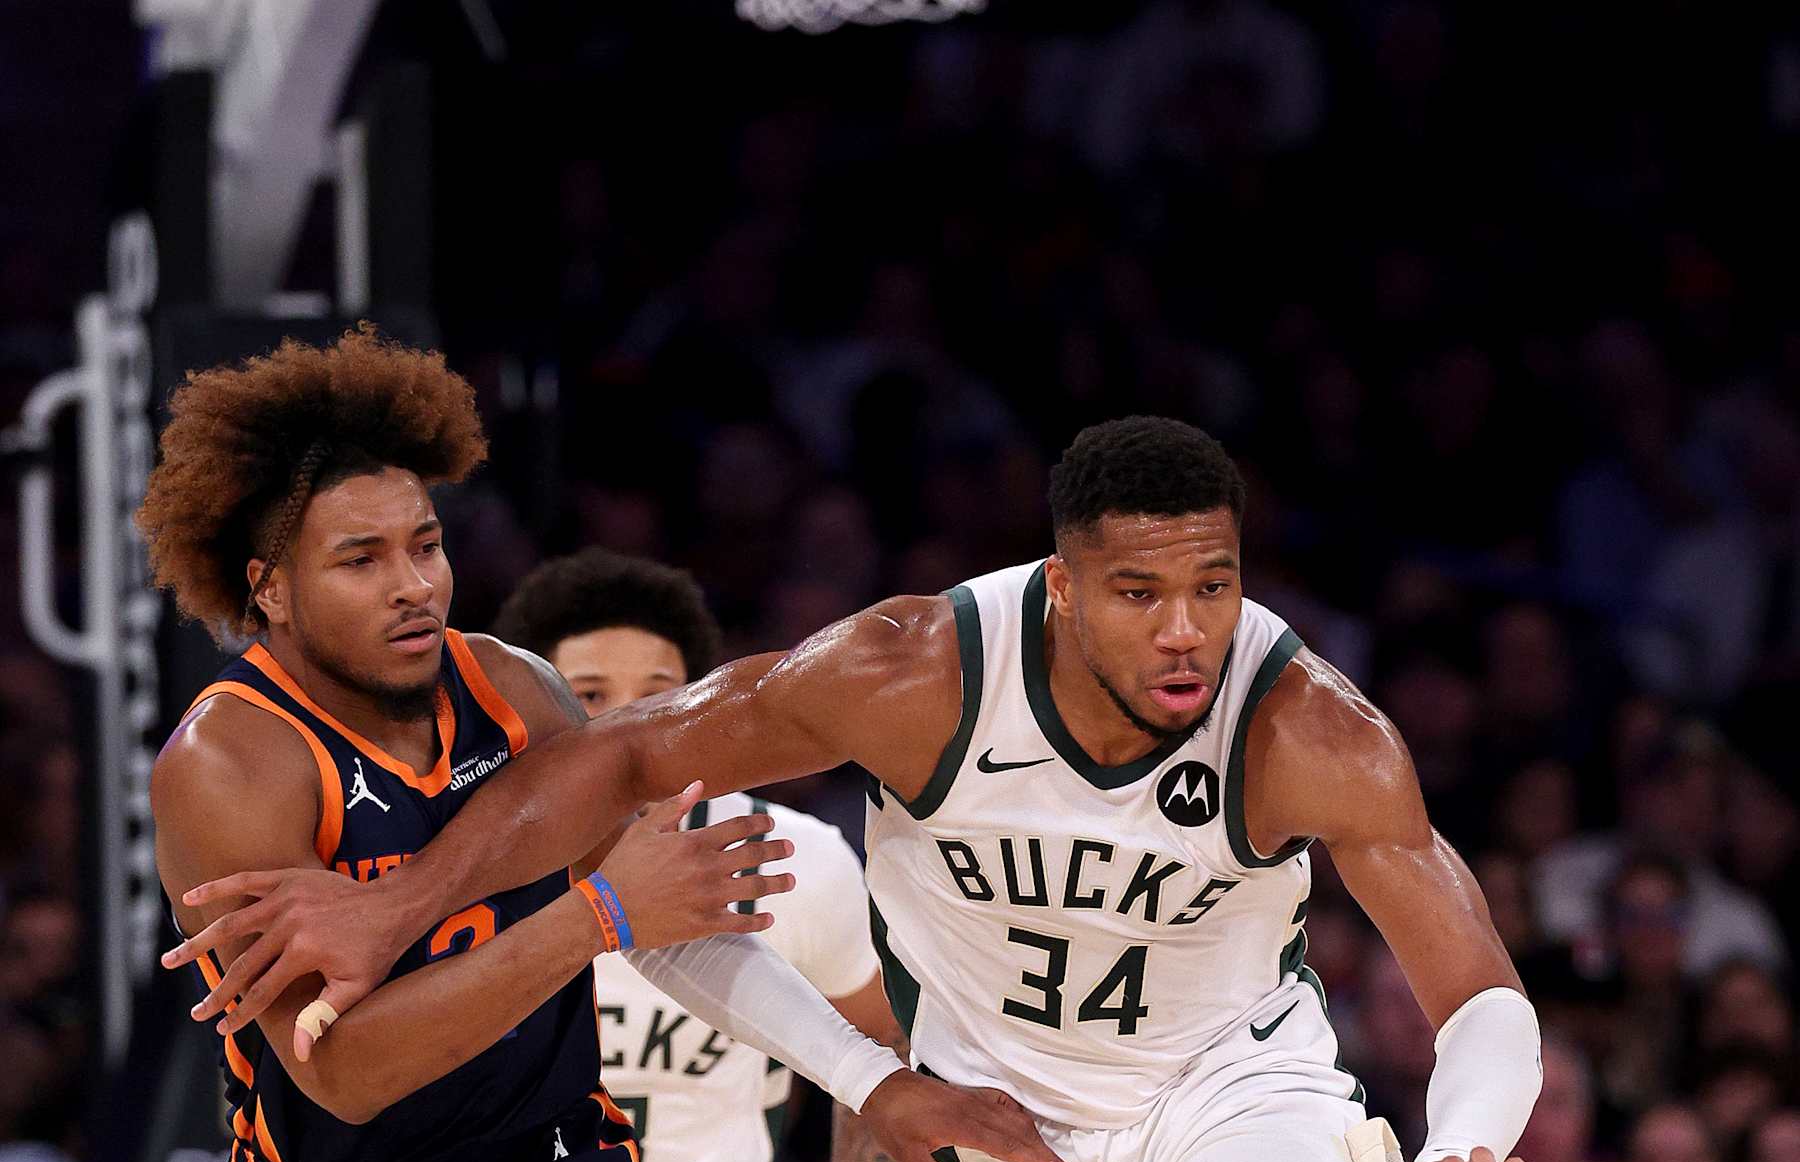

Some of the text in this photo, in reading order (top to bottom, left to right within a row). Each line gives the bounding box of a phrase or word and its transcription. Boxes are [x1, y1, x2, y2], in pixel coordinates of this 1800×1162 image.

[450, 747, 508, 791] abu dhabi
[935, 837, 1242, 926] BUCKS
[1001, 926, 1150, 1036] 34
[598, 1006, 735, 1075] CKS
